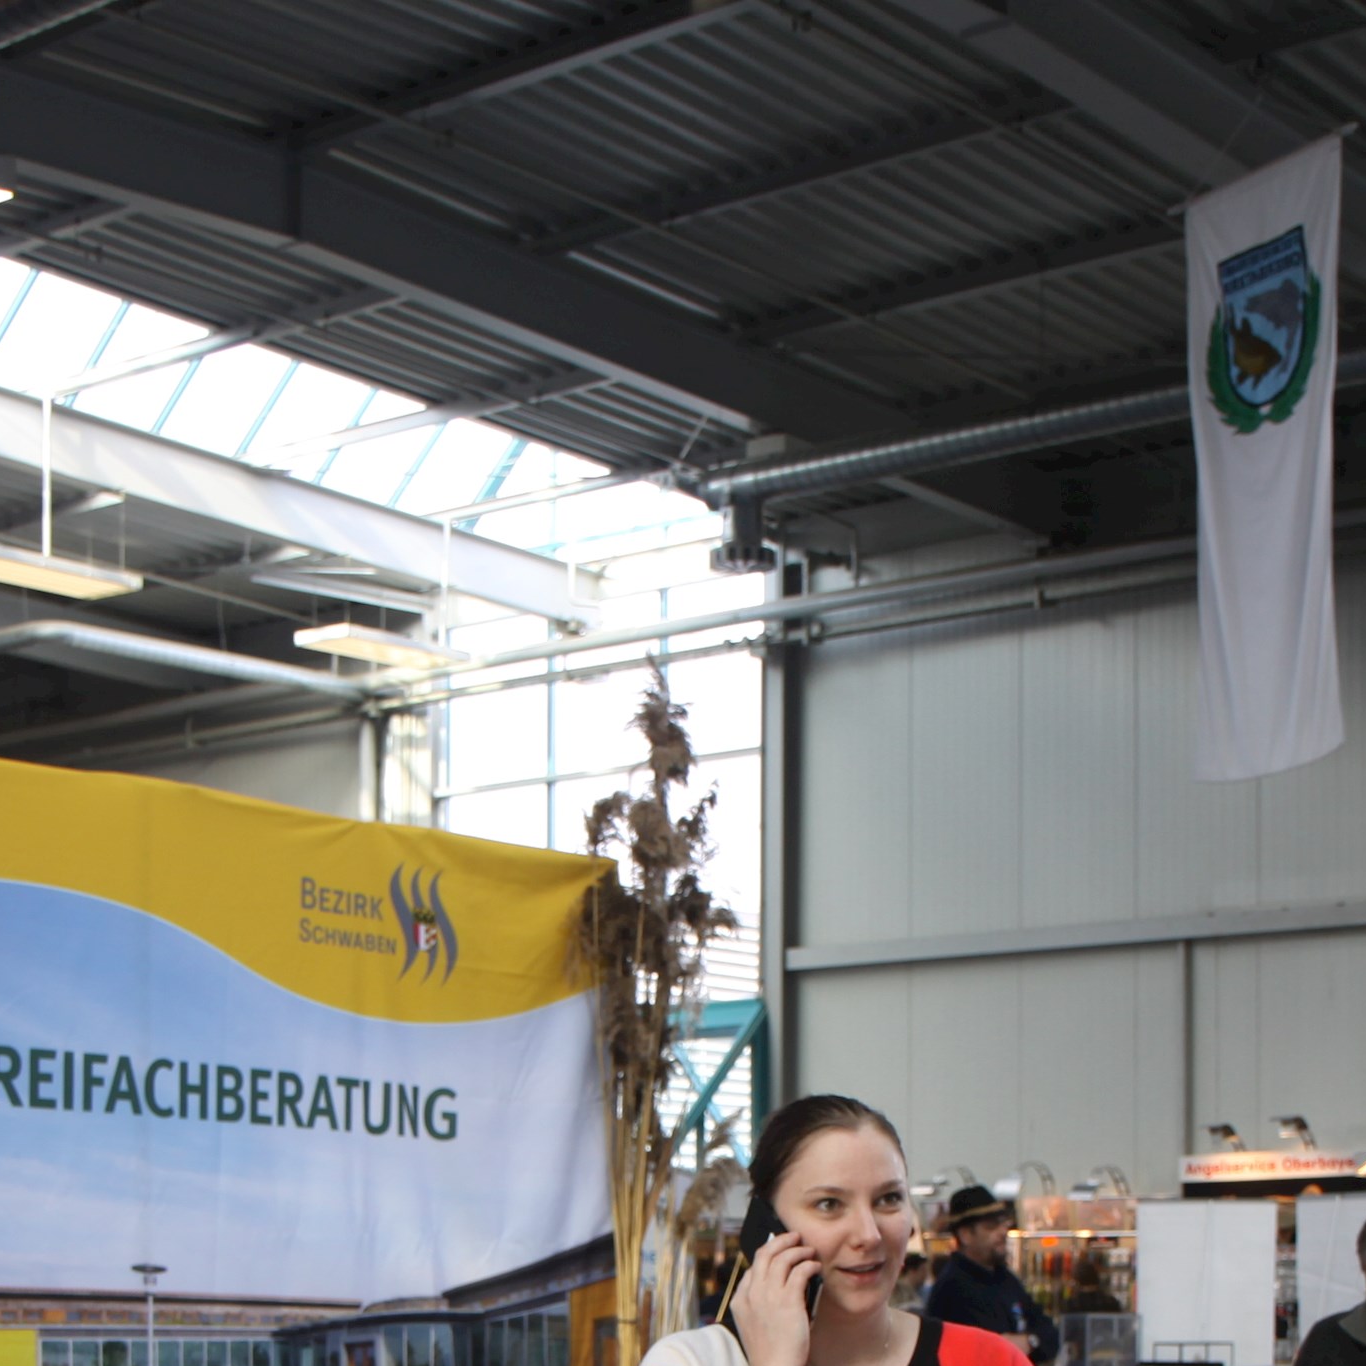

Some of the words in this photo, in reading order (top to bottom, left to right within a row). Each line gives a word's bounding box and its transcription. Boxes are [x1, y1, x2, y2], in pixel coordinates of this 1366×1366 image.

[300, 876, 384, 921] BEZIRK
[298, 917, 397, 955] SCHWABEN
[1185, 1160, 1276, 1179] Angelservice
